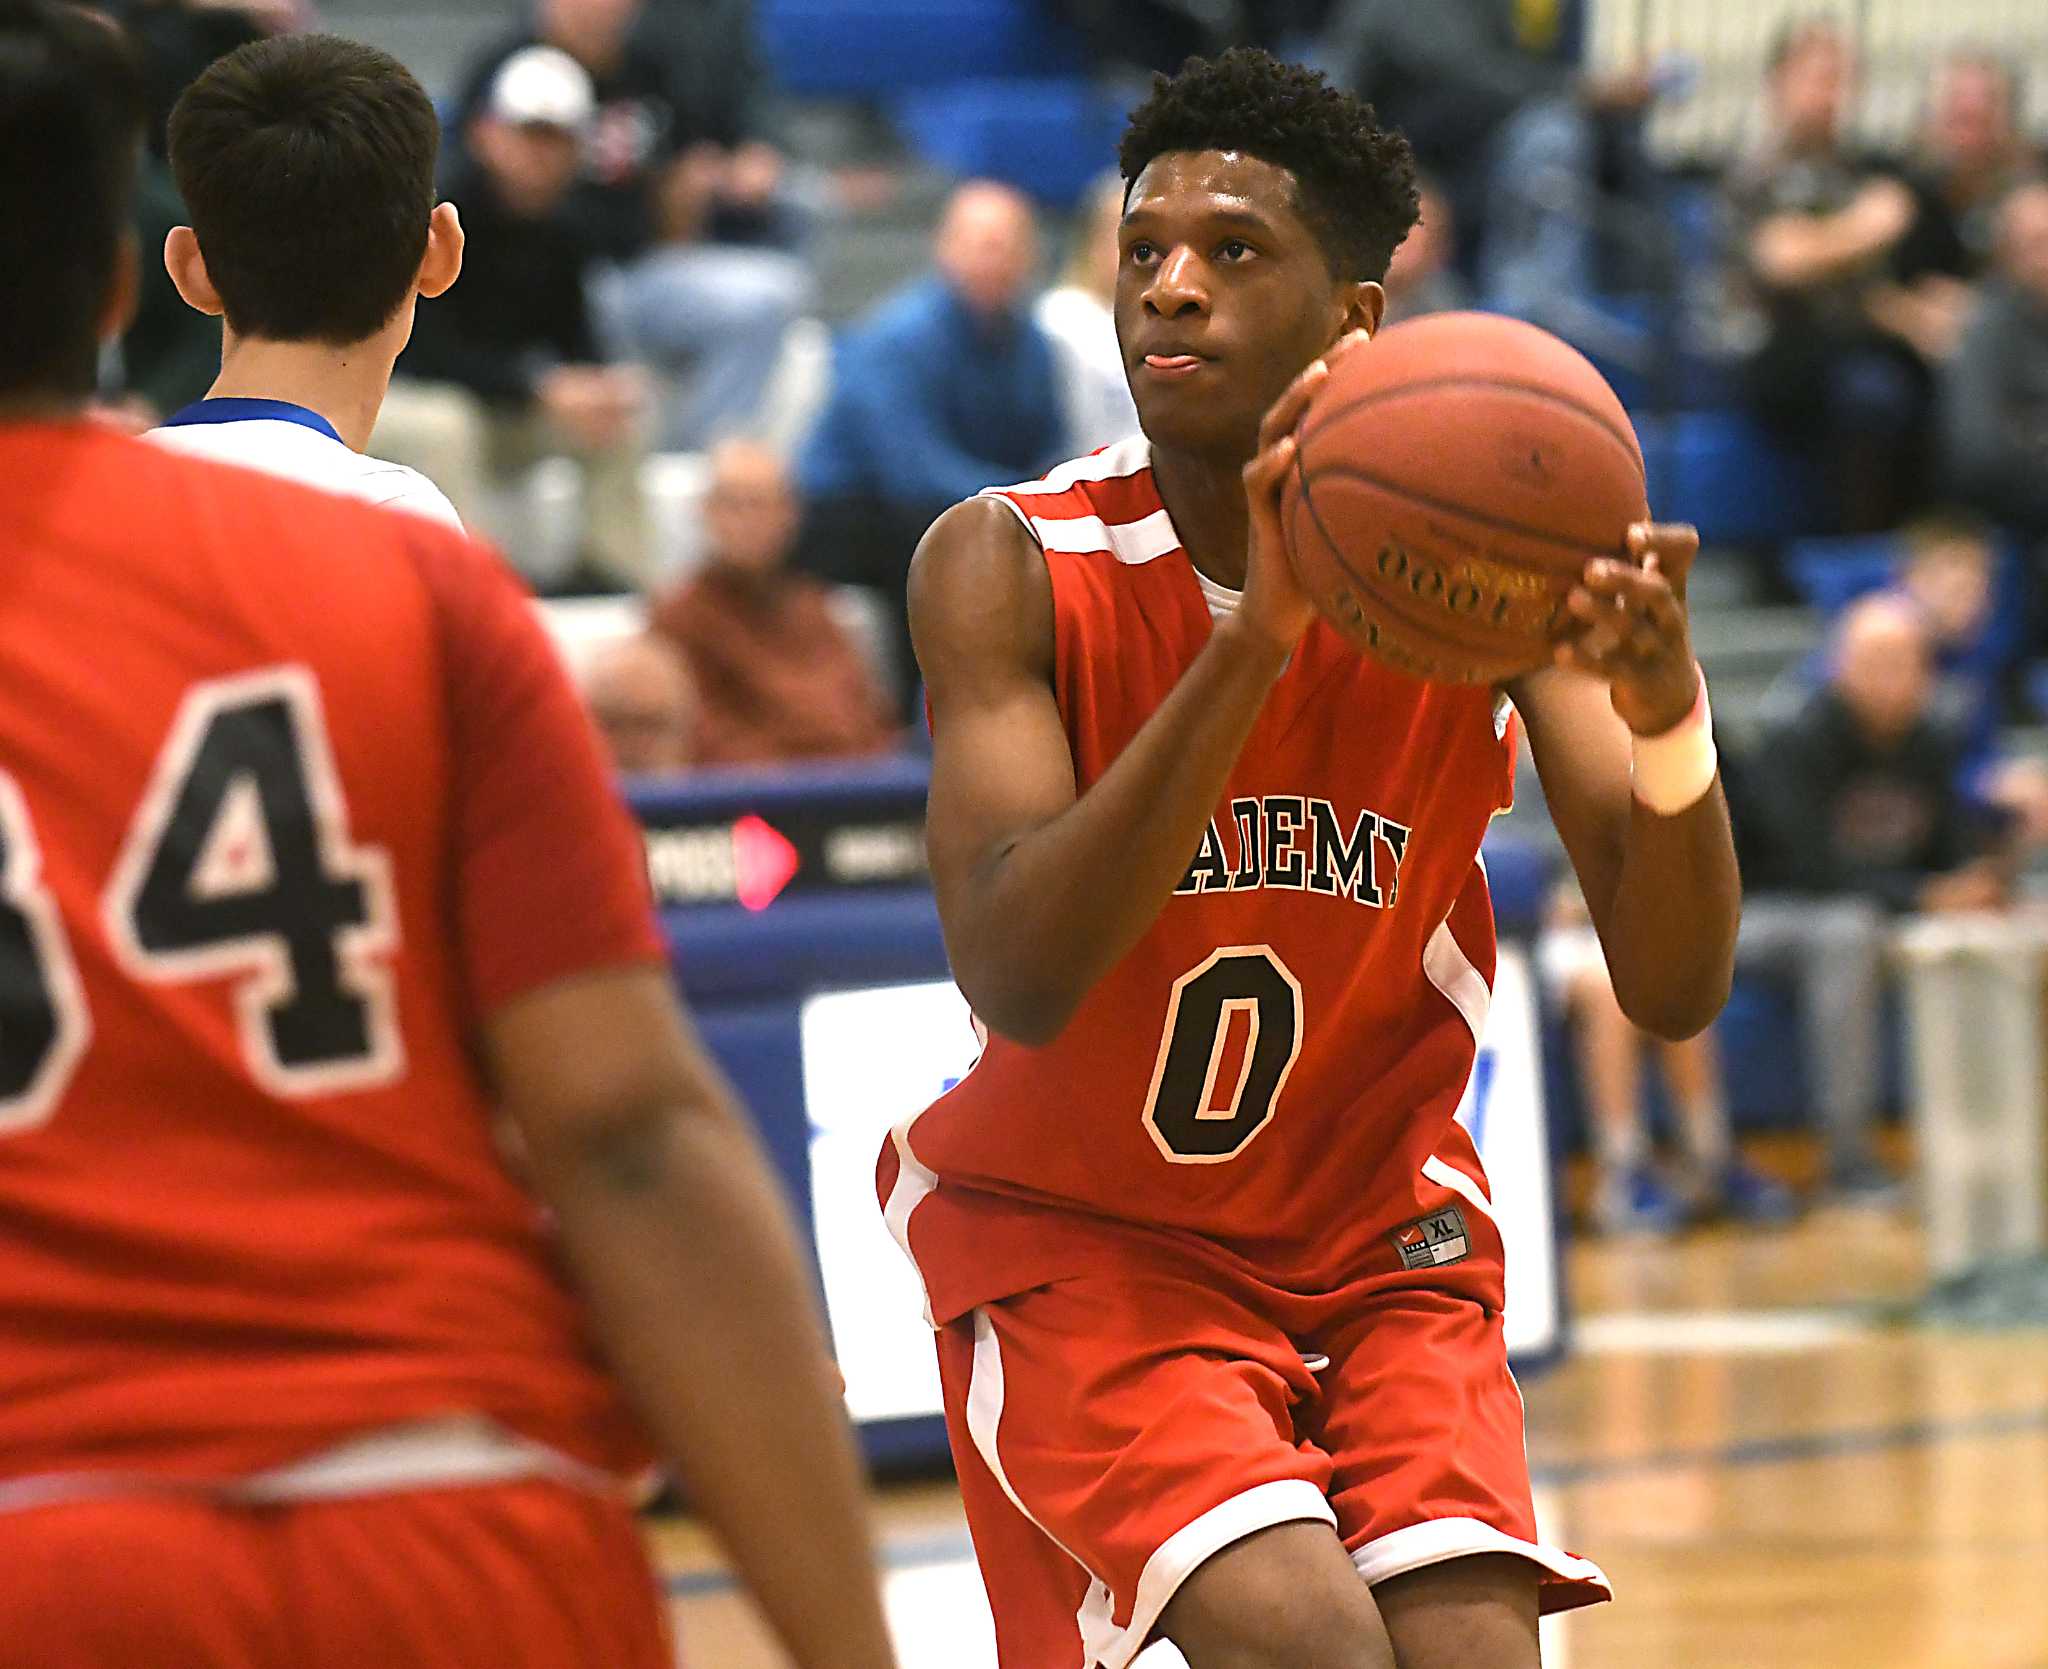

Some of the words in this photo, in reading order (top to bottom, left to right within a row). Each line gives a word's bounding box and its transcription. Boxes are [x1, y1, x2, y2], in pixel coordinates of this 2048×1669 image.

[1142, 944, 1304, 1165] 0
[1429, 1218, 1454, 1239] XL
[1405, 1241, 1426, 1252] TEAM
